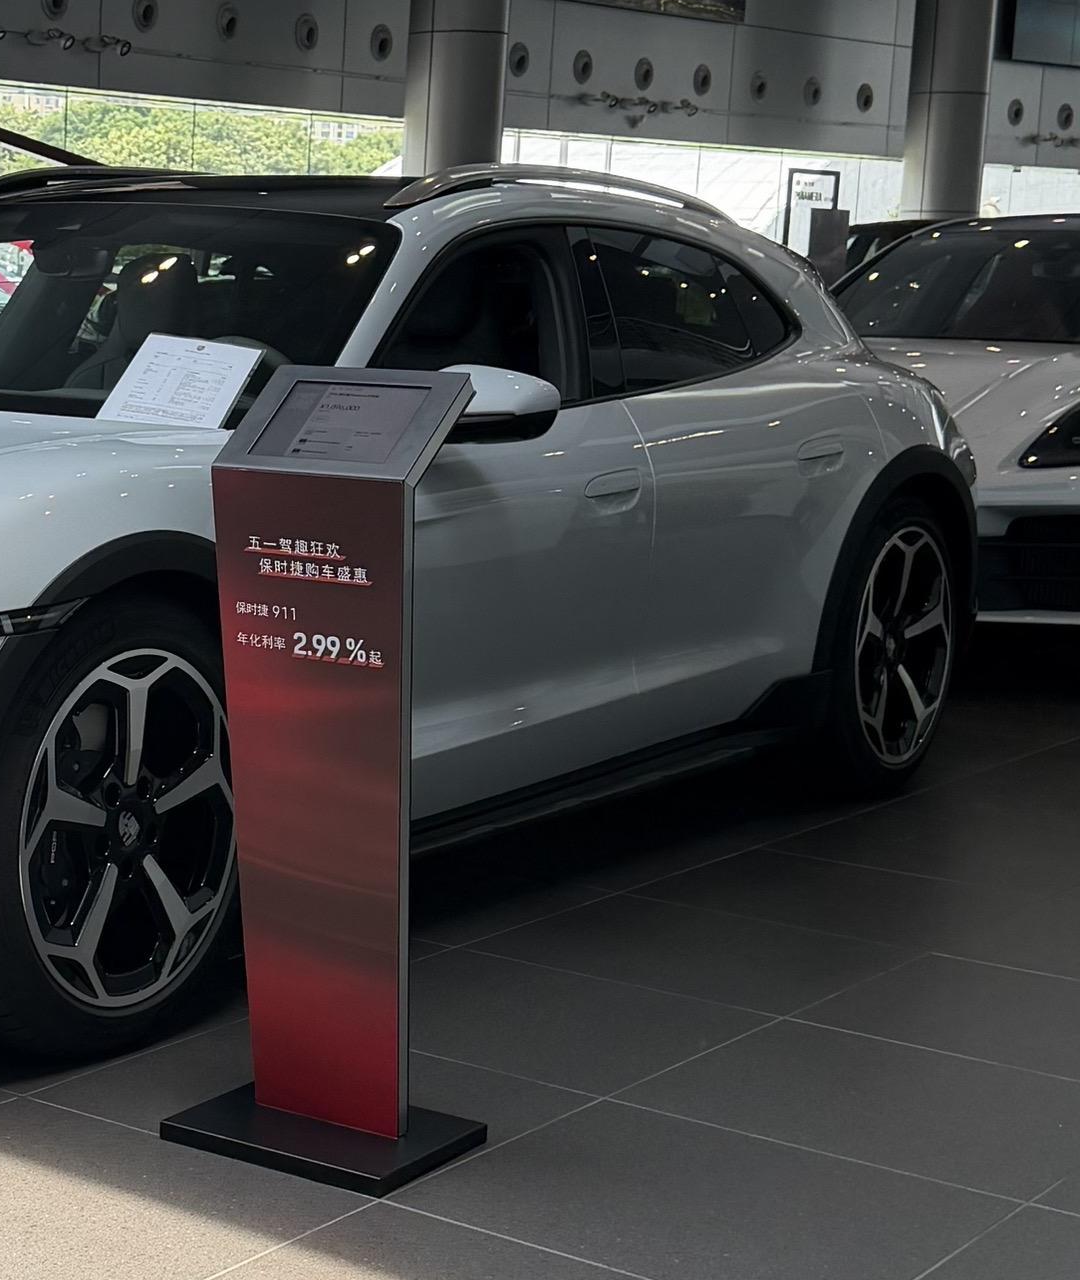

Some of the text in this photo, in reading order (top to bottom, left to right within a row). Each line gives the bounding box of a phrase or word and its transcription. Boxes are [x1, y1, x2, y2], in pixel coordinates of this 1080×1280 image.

[248, 535, 342, 559] 五一驾趣狂欢
[259, 558, 369, 584] 保时捷购车盛惠
[235, 601, 297, 621] 保时捷 911
[237, 632, 287, 651] 年化利率
